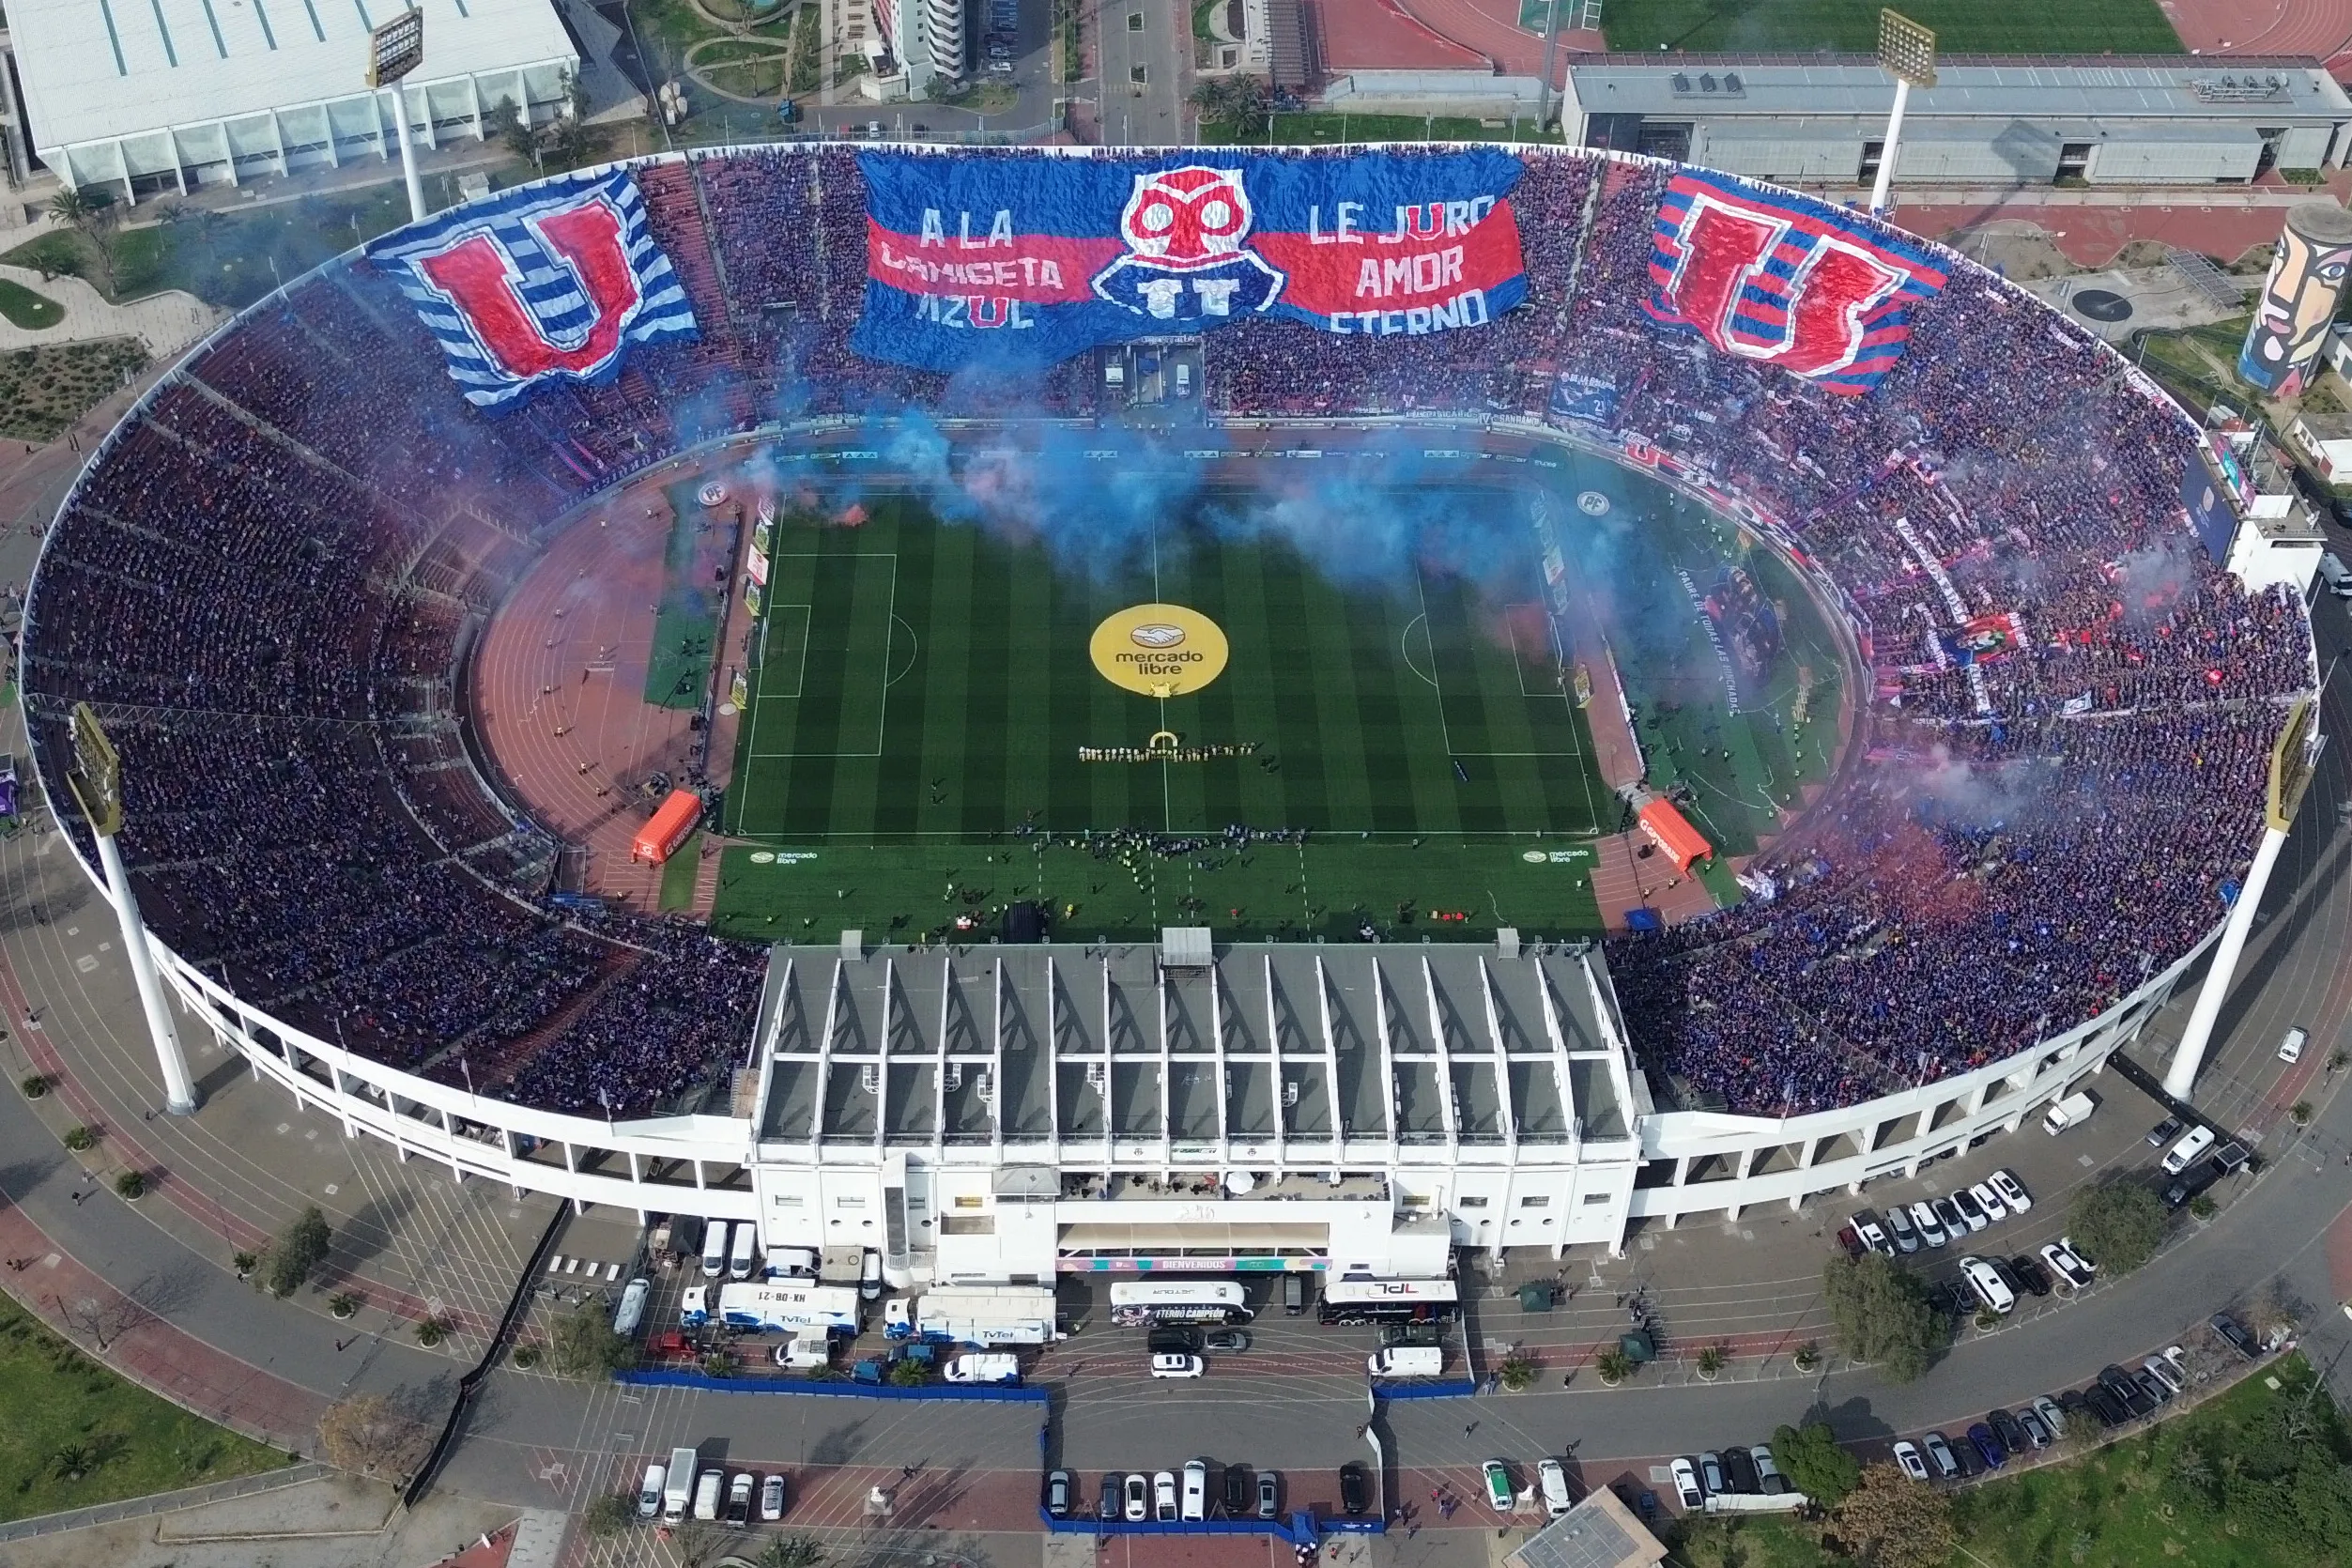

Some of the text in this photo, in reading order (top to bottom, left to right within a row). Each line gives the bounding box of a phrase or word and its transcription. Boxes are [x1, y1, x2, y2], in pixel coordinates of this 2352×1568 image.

[920, 208, 1013, 249] A LA
[1310, 194, 1496, 244] LE JURO
[881, 240, 1064, 289] CAMISETA
[1355, 245, 1464, 298] AMOR
[399, 192, 643, 381] U
[1666, 192, 1912, 377] U
[915, 291, 1034, 329] AZUL
[1330, 288, 1489, 335] ETERNO
[706, 484, 722, 501] PF
[1583, 495, 1603, 510] PF
[1678, 571, 1700, 599] PADRE
[1693, 601, 1705, 611] DE
[1699, 615, 1721, 642] TODAS
[1714, 640, 1729, 663] LAS
[1115, 650, 1204, 662] mercado
[1138, 663, 1182, 675] libre
[1549, 850, 1589, 858] mercado
[1162, 1260, 1226, 1268] BIENVENIDOS
[780, 1315, 811, 1324] TvTel
